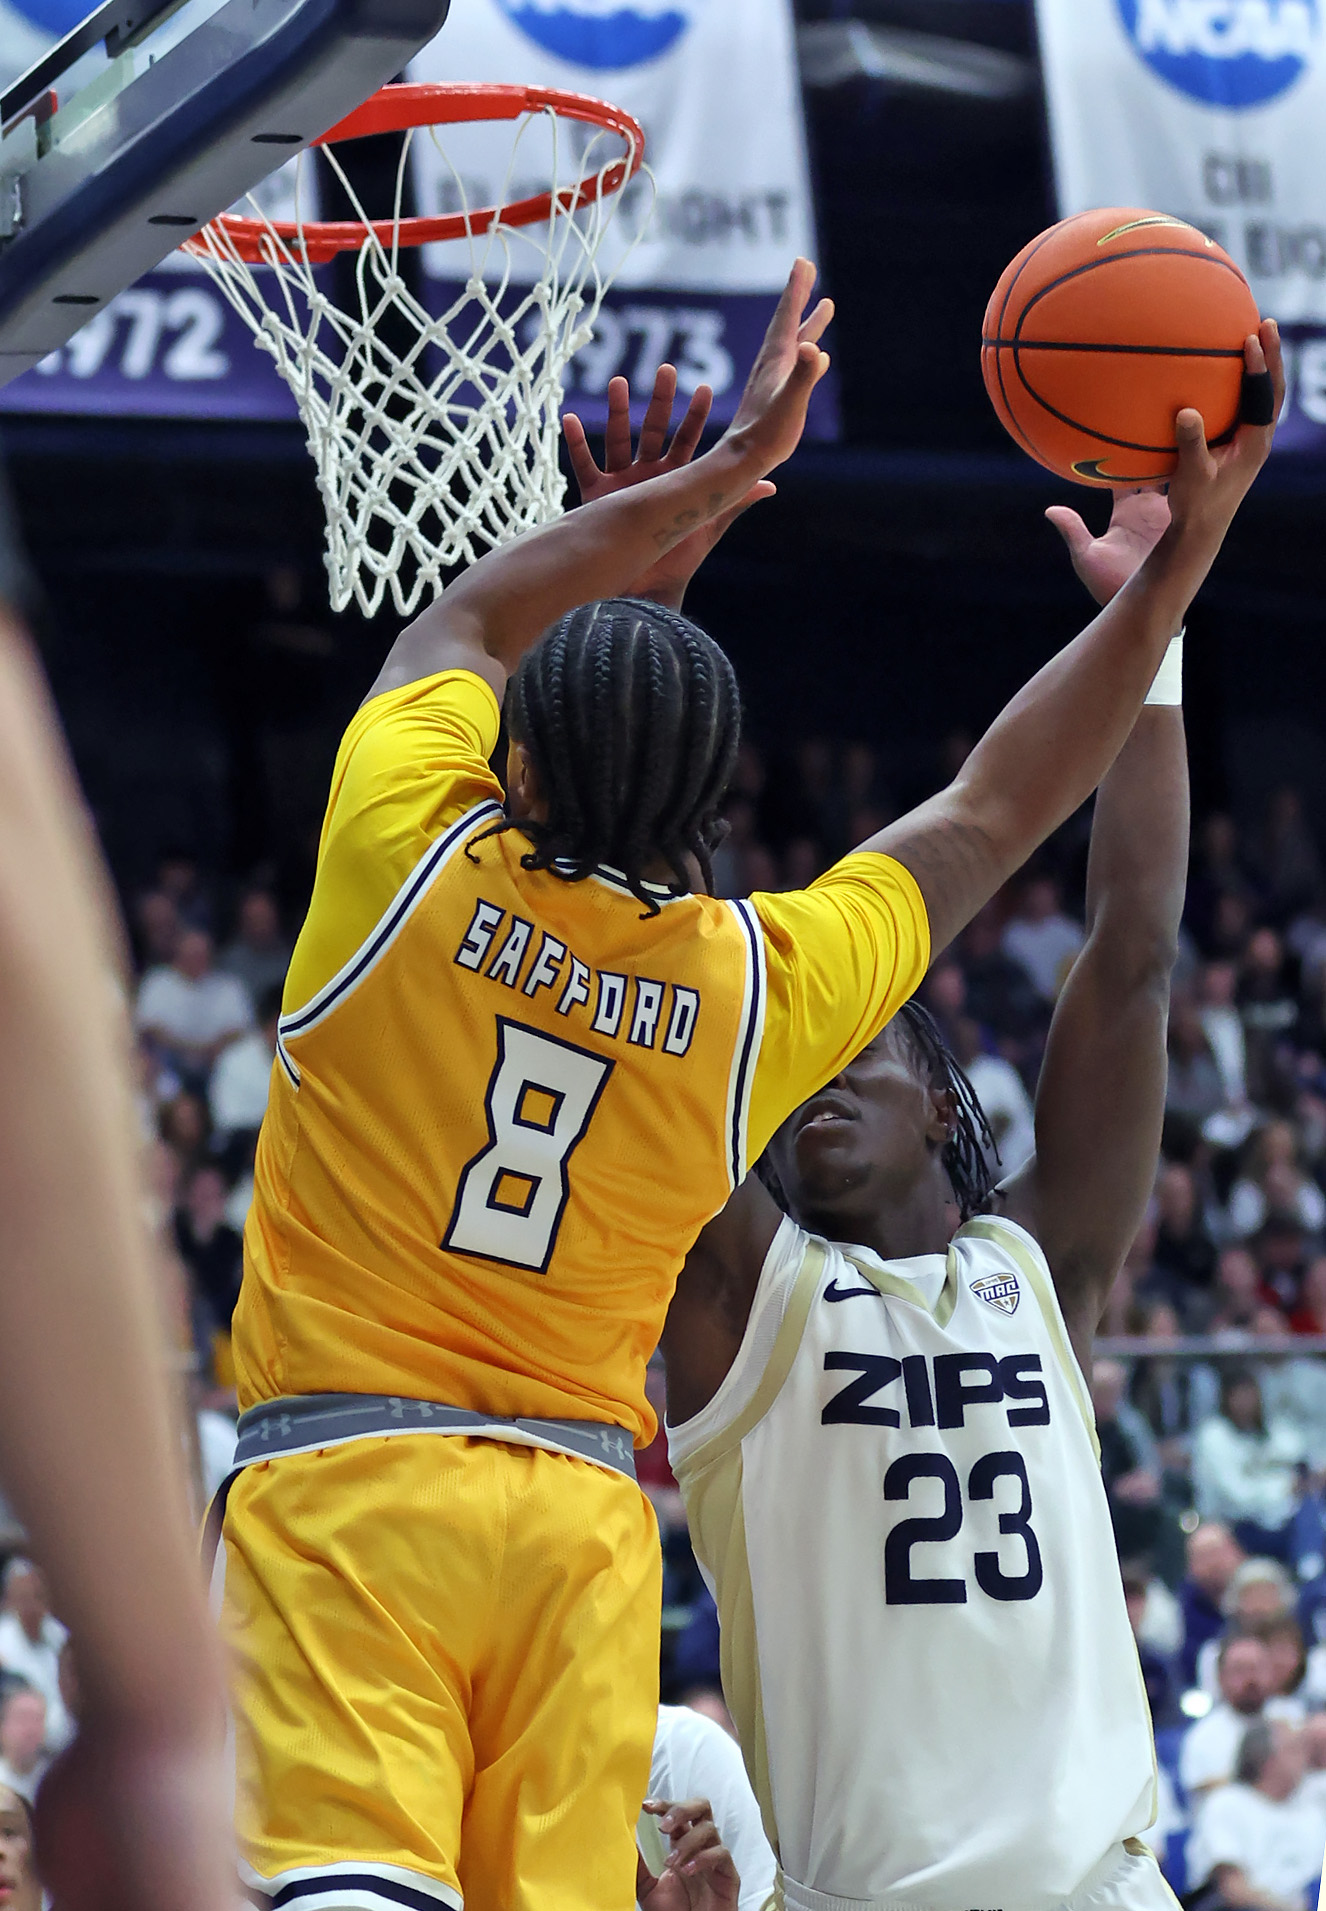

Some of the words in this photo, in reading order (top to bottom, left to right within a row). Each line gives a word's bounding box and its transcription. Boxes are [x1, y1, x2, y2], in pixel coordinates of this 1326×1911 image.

[35, 287, 230, 381] 972
[453, 897, 700, 1058] SAFFORD
[440, 1014, 616, 1275] 8
[979, 1281, 1017, 1301] MAC
[821, 1351, 1050, 1429] ZIPS
[884, 1451, 1043, 1604] 23
